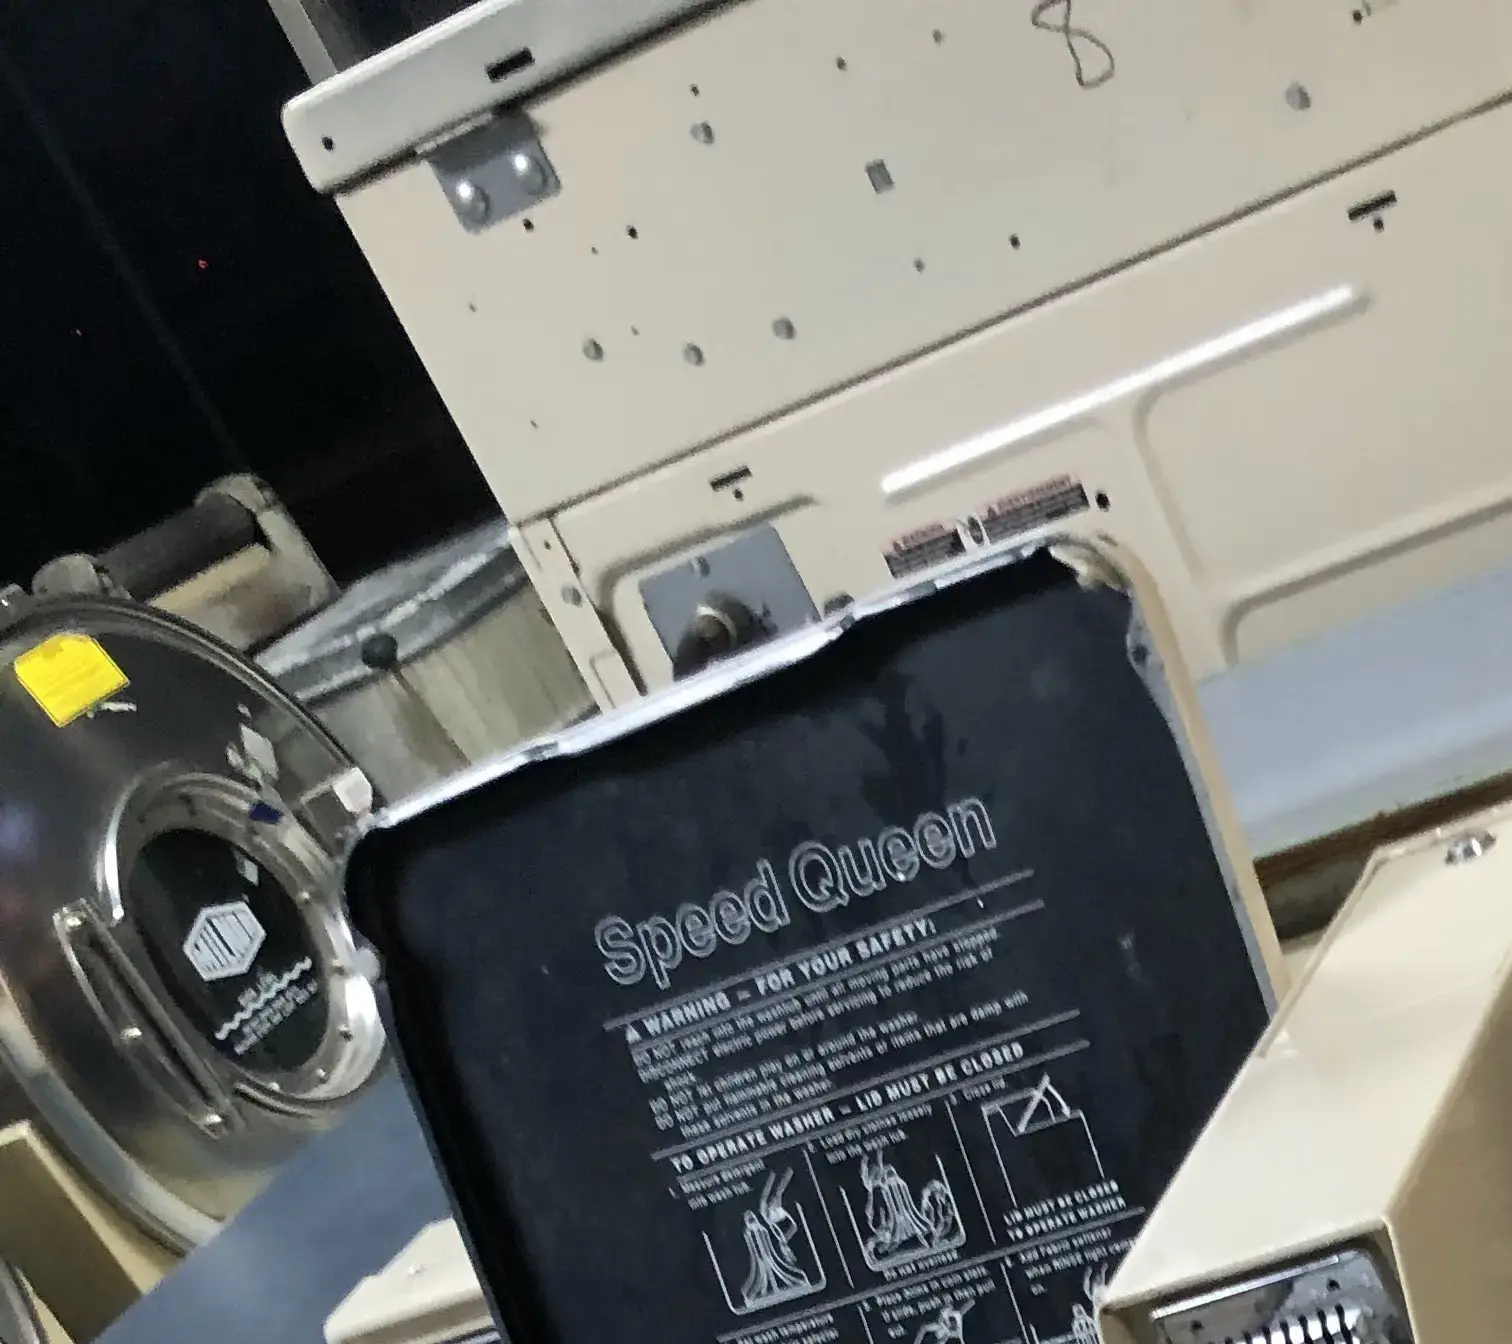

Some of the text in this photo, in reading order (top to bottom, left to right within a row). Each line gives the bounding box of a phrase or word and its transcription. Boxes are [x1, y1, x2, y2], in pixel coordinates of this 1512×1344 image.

[593, 797, 997, 989] Speed Queen
[642, 990, 731, 1036] WARNING
[754, 966, 795, 996] FOR
[796, 946, 853, 981] YOUR
[670, 1152, 695, 1174] TO
[695, 1128, 767, 1166] OPERATE
[767, 1105, 835, 1141] WASHER
[854, 1089, 884, 1112] LID
[884, 1072, 932, 1102] MUST
[933, 1063, 958, 1086] BE
[959, 1041, 1025, 1077] CLOSED
